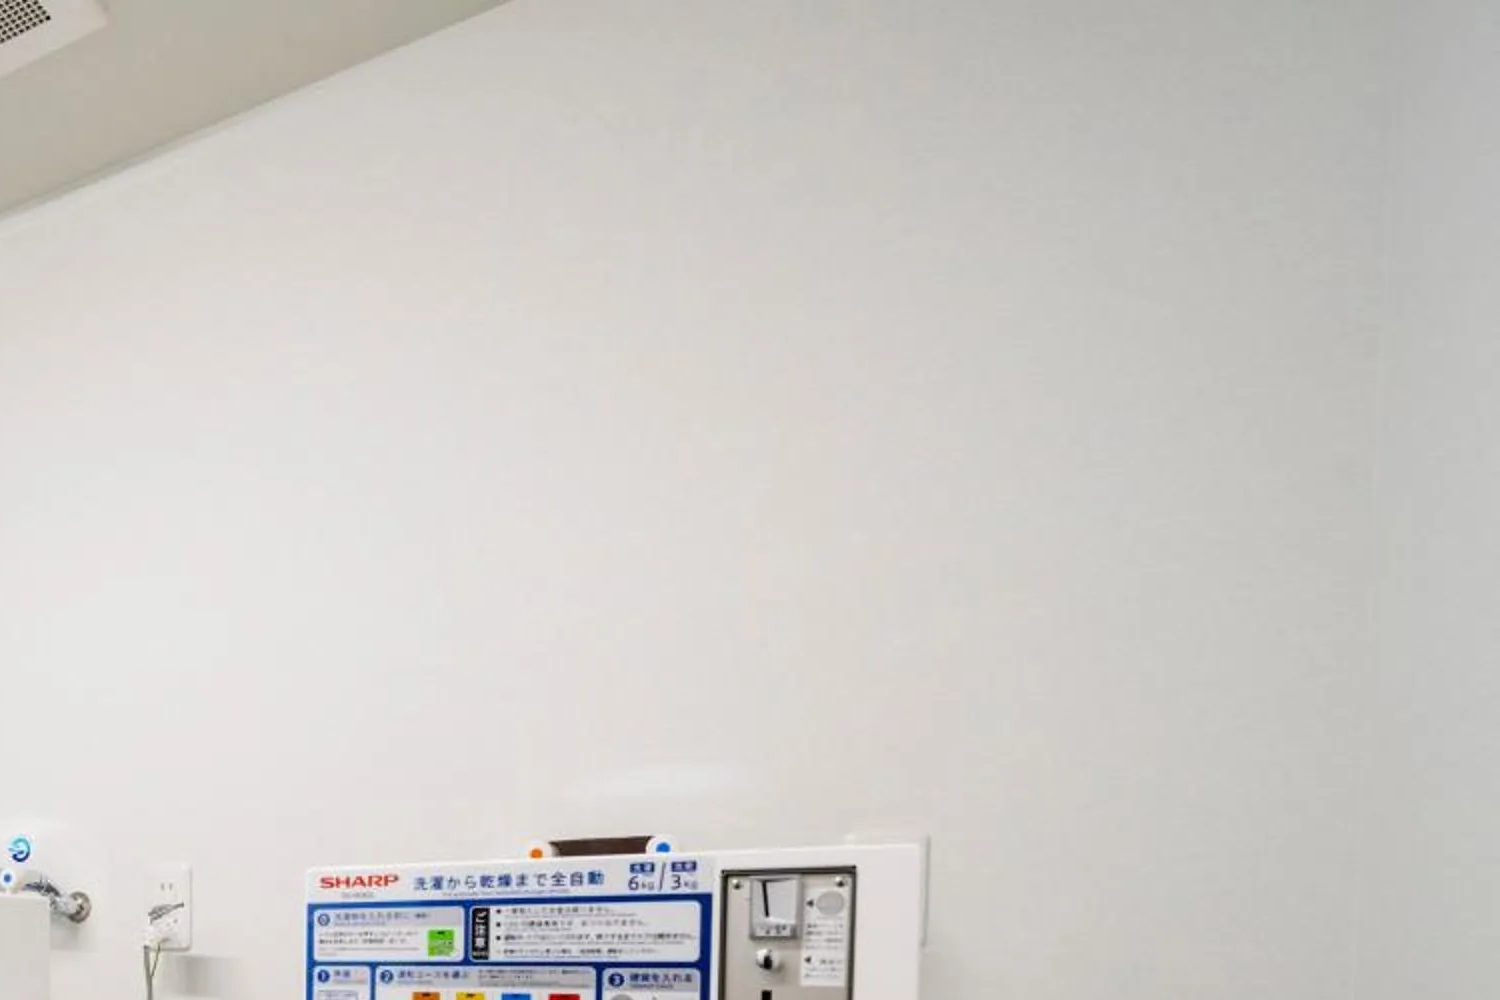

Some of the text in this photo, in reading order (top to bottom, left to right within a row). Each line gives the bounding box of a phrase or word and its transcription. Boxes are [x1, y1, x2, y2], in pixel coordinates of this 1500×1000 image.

[320, 874, 399, 889] SHARP
[413, 870, 605, 892] 洗濯から乾燥まで全自動
